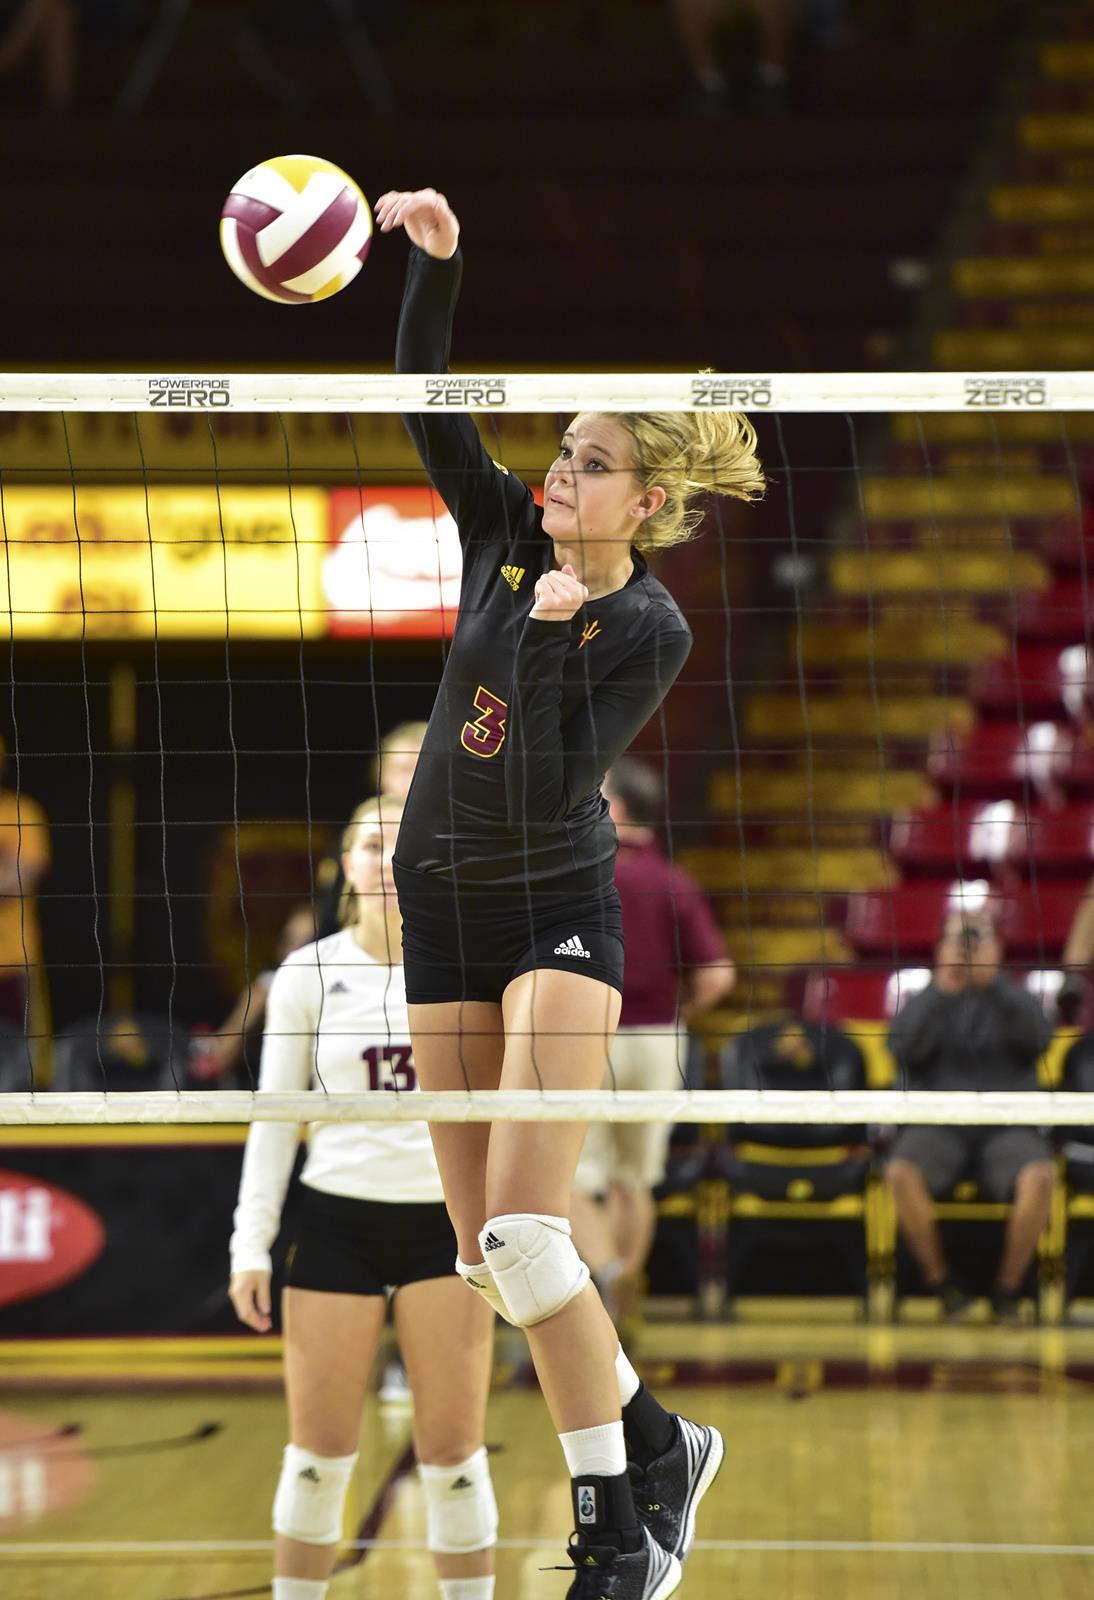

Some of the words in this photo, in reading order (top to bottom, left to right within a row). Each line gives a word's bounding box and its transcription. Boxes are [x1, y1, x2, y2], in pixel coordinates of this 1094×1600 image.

[148, 379, 230, 389] POWERADE
[425, 379, 506, 388] POWERADE
[148, 390, 230, 406] ZERO
[426, 389, 506, 406] ZERO
[692, 390, 772, 406] ZERO
[965, 389, 1046, 406] ZERO
[500, 565, 520, 591] adidas
[461, 685, 507, 758] 3
[553, 947, 591, 958] adidas
[361, 1046, 416, 1092] 13
